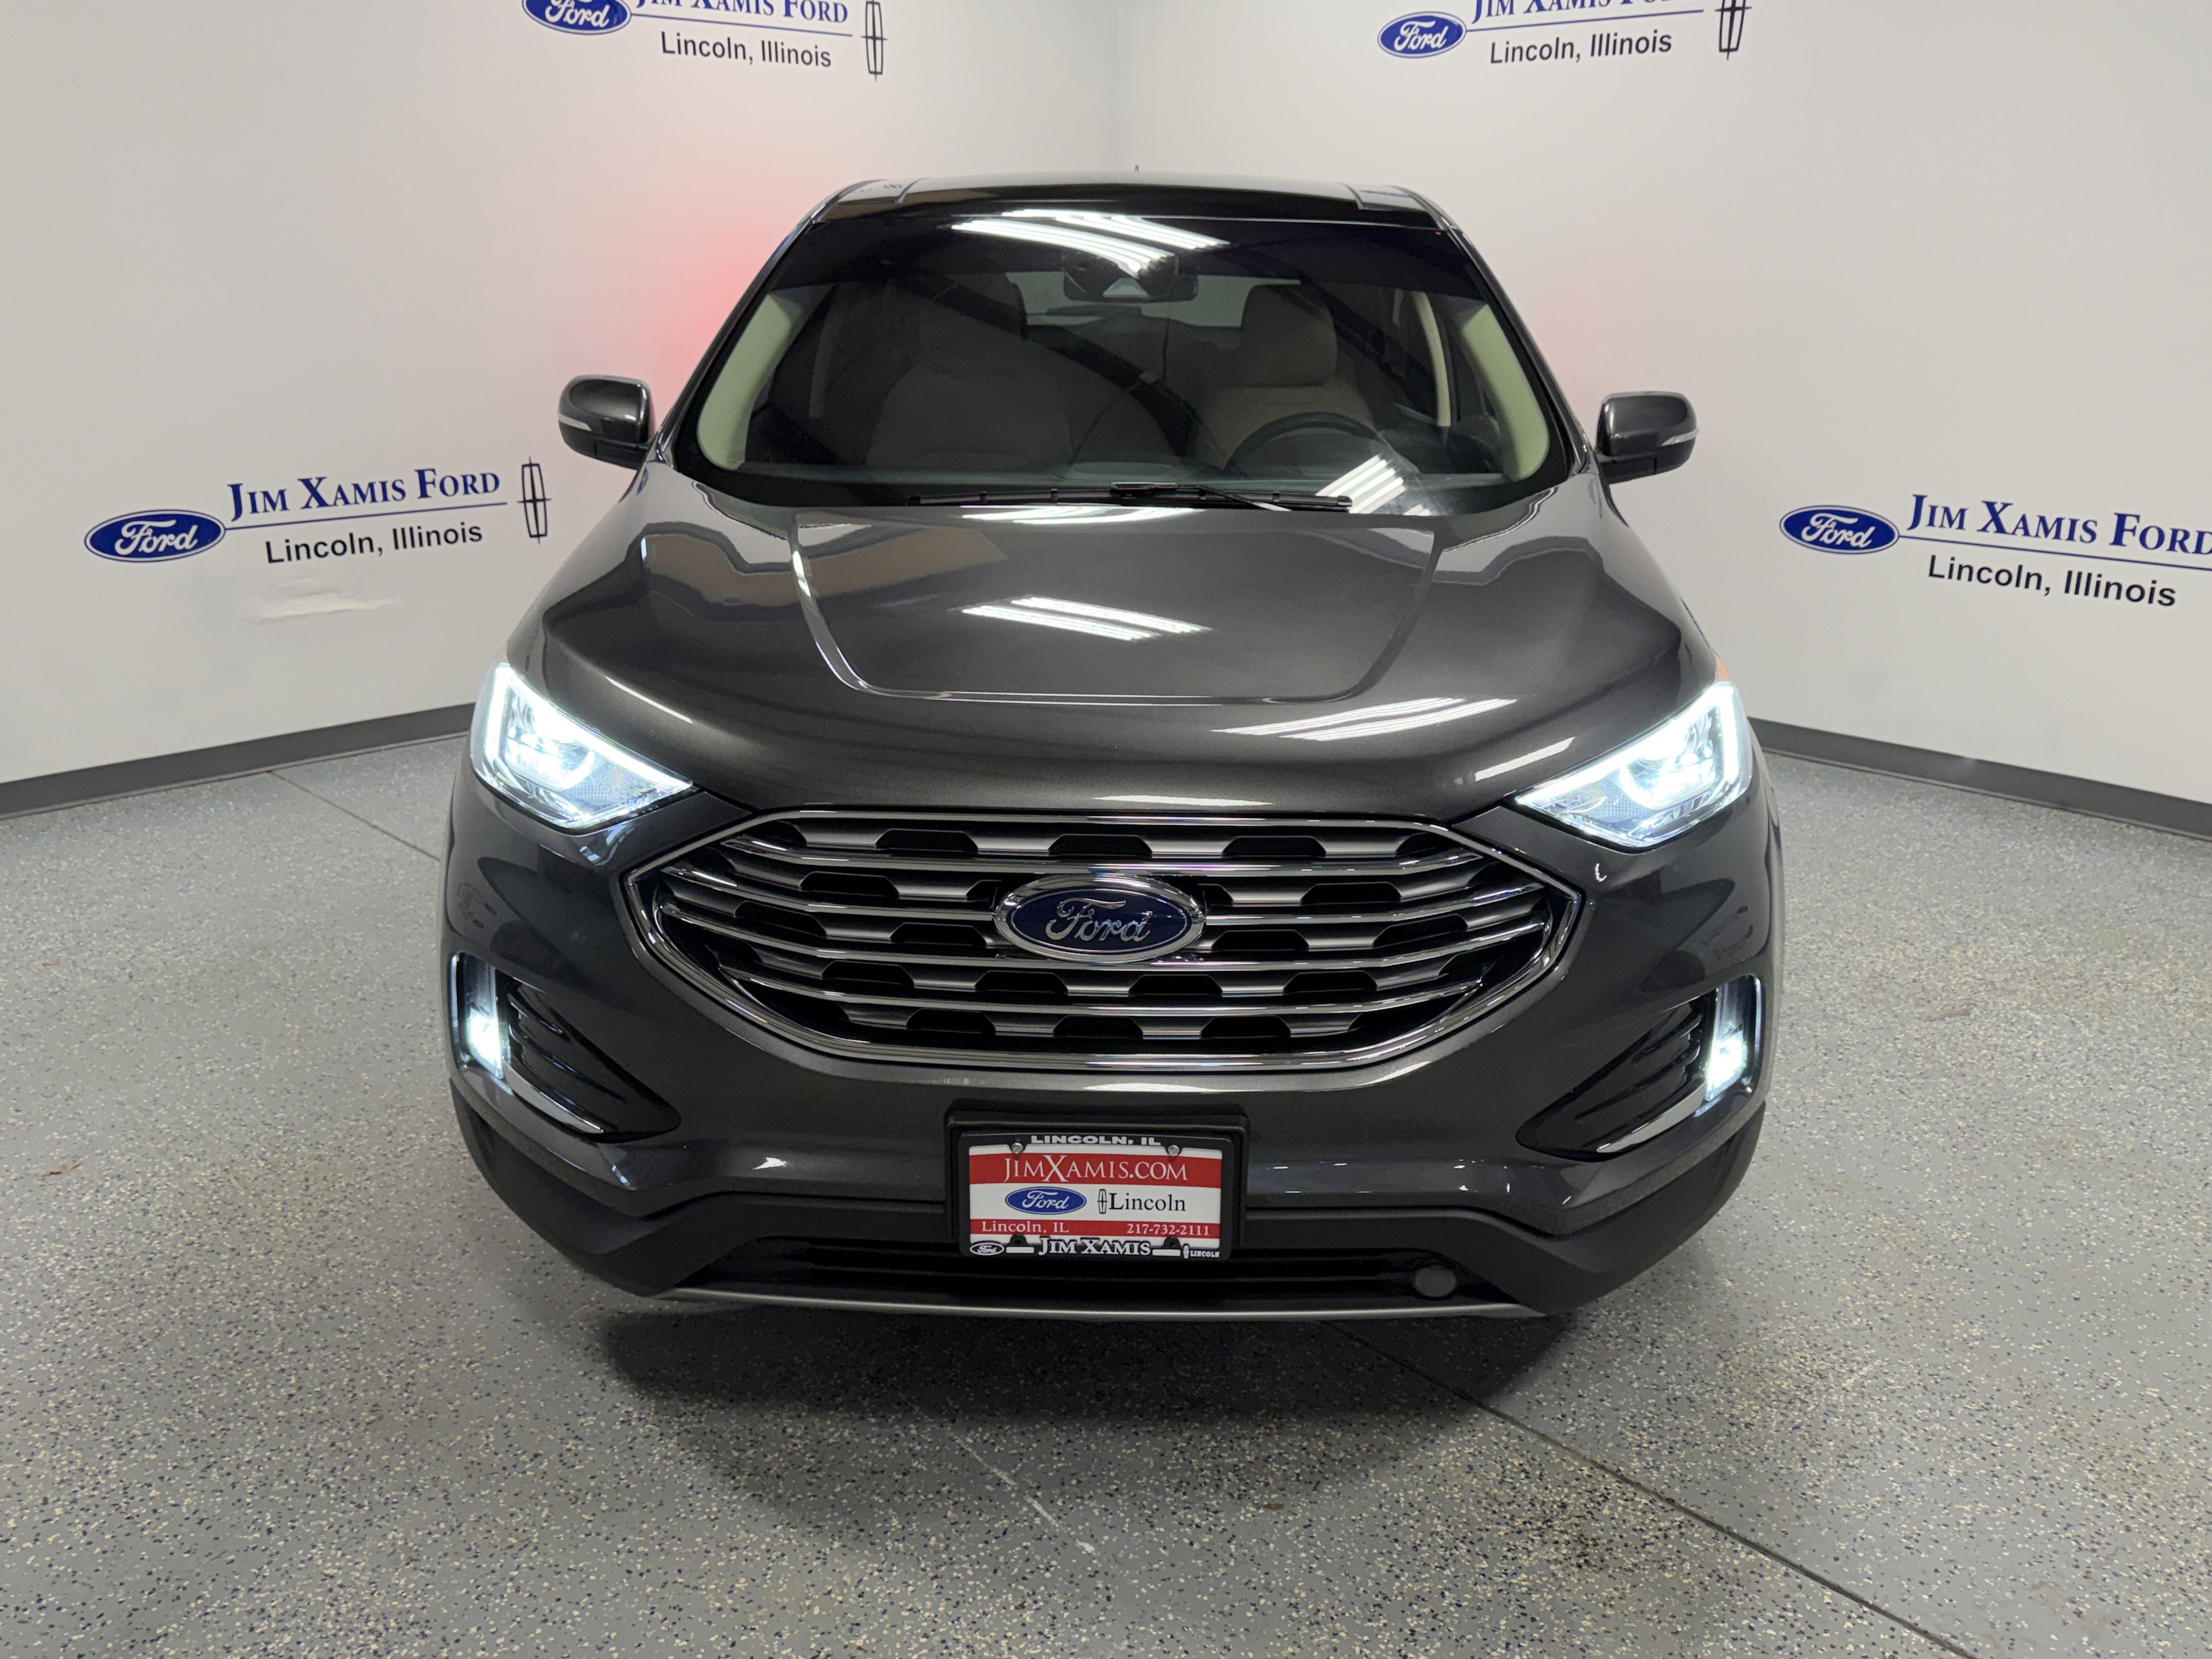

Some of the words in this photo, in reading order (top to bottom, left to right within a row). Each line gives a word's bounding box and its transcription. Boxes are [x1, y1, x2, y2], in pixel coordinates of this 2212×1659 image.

[545, 0, 610, 27] Ford
[783, 0, 848, 22] FORD
[661, 31, 753, 65] Lincoln,
[761, 40, 831, 67] Illinois
[1394, 20, 1448, 50] Ford
[1490, 37, 1581, 64] Lincoln,
[1590, 30, 1672, 57] Illinois
[228, 483, 289, 522] JIM
[297, 476, 406, 510] XAMIS
[414, 468, 500, 499] FORD
[115, 520, 198, 555] Ford
[1801, 512, 1876, 548] Ford
[1906, 494, 1968, 531] JIM
[1977, 500, 2097, 544] XAMIS
[2109, 512, 2212, 555] FORD
[266, 532, 382, 564] Lincoln,
[392, 522, 483, 550] Illinois
[1928, 555, 2050, 596] Lincoln,
[2064, 570, 2176, 607] Illinois
[1045, 897, 1153, 941] Ford
[1031, 1135, 1134, 1146] LINCOLN,
[1141, 1137, 1161, 1146] IL
[1022, 1190, 1069, 1209] Ford
[1109, 1192, 1187, 1211] Lincoln
[981, 1221, 1047, 1234] Lincoln,
[1053, 1222, 1070, 1233] IL
[1126, 1223, 1210, 1236] 217-732-2111
[977, 1245, 997, 1254] Ford
[1038, 1237, 1077, 1256] JIM
[1080, 1238, 1152, 1256] XAMIS
[1189, 1250, 1220, 1258] LINCOLN
